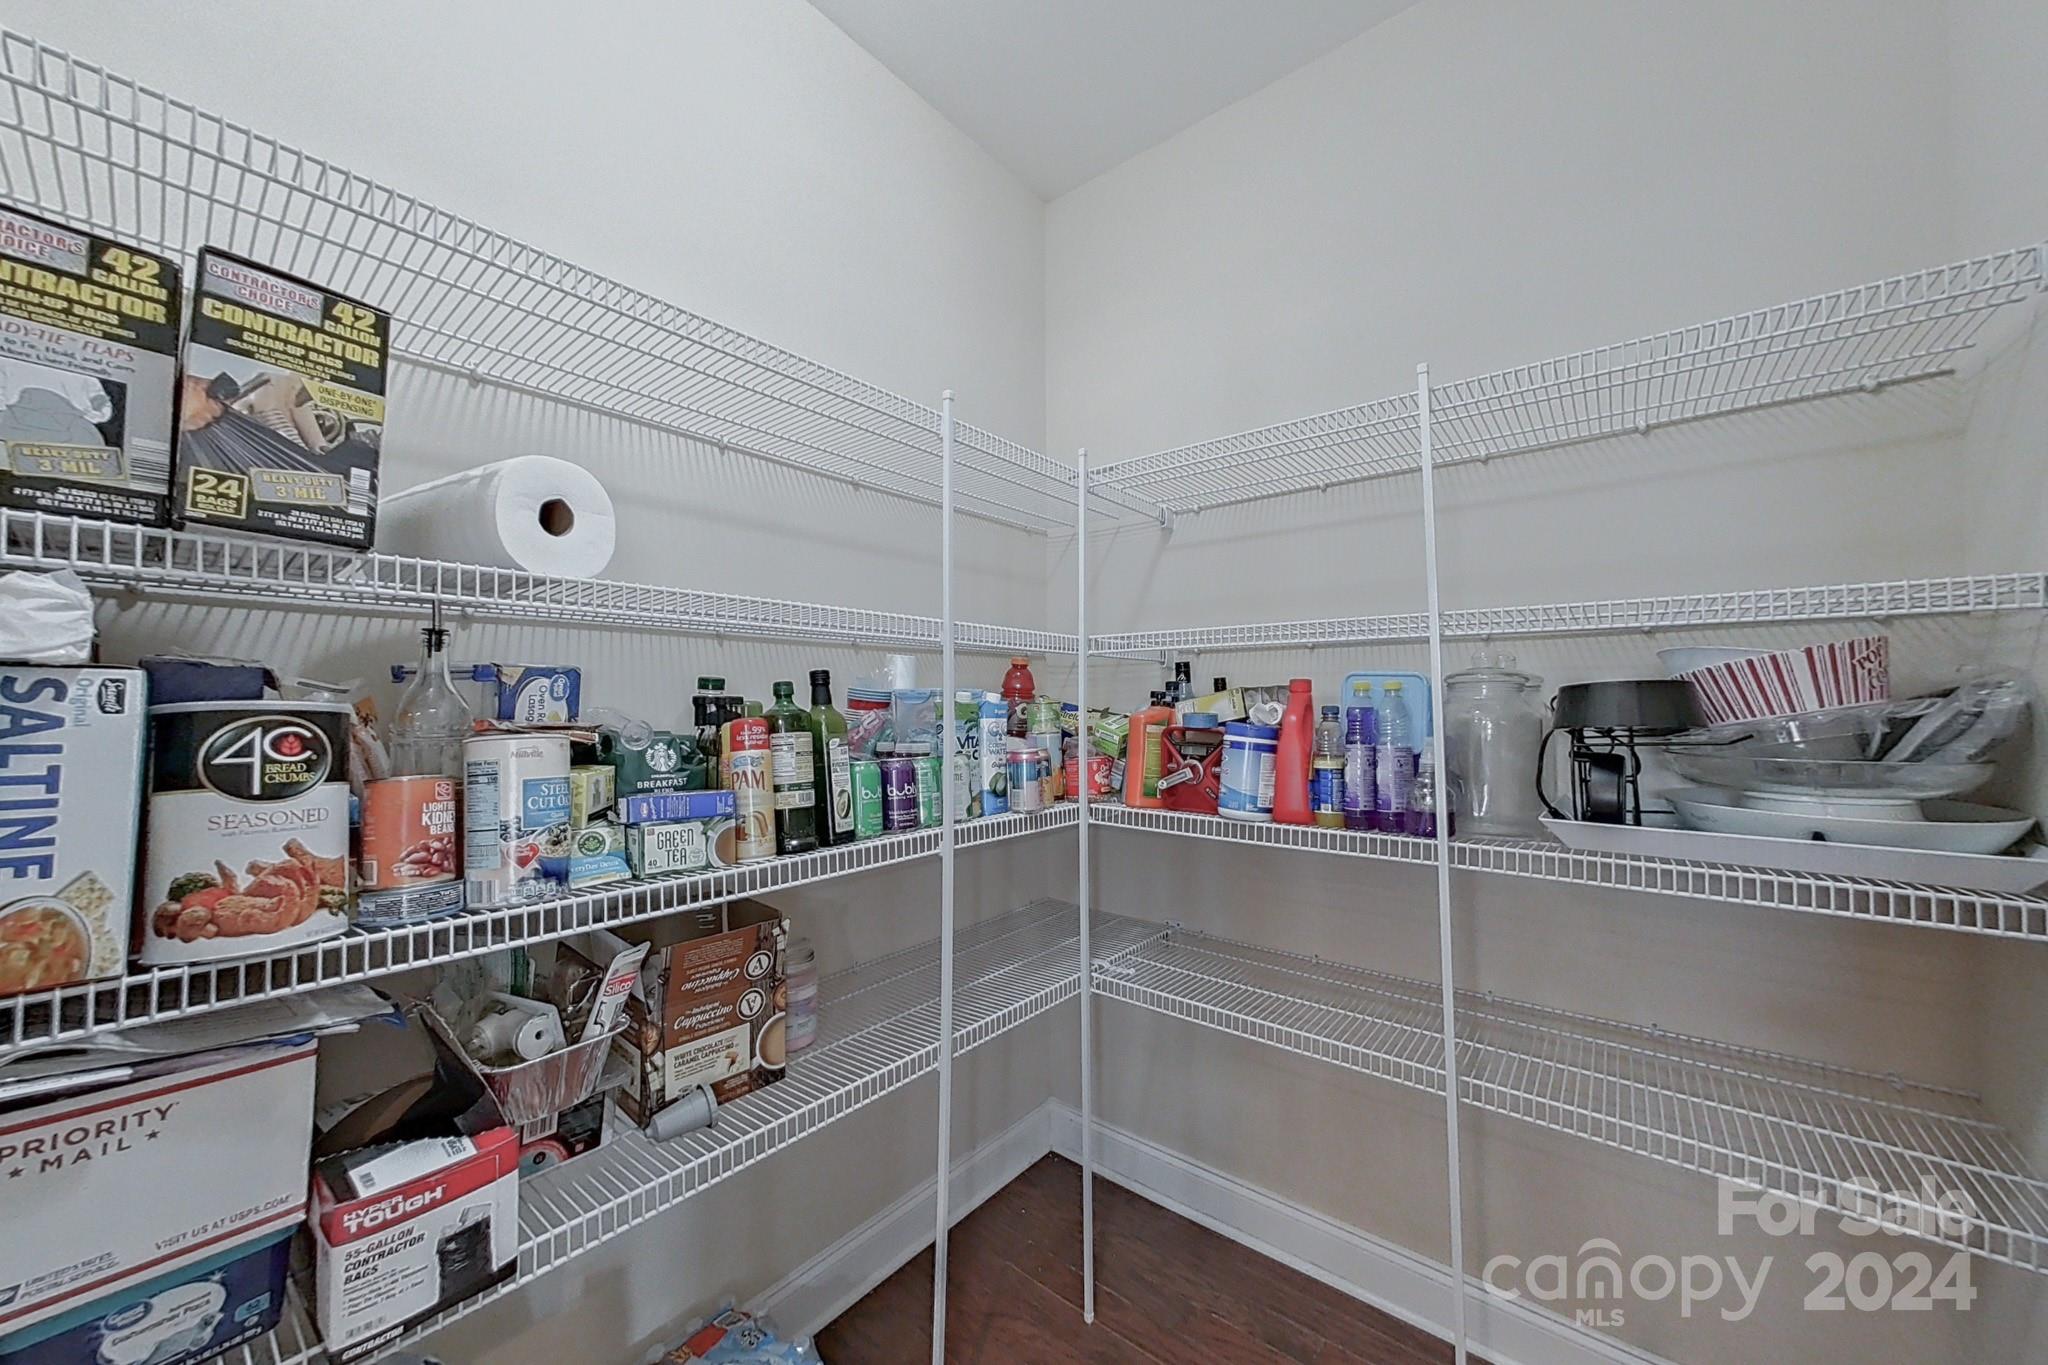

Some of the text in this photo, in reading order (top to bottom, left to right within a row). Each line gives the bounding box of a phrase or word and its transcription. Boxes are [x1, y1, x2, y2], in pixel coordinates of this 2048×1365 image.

[0, 219, 87, 255] ACTOR'S
[101, 247, 161, 285] 42
[92, 269, 168, 301] GALLON
[208, 263, 321, 310] CONTRACTOR'S
[237, 286, 294, 311] CHOICE
[72, 303, 120, 325] BAGS
[332, 301, 377, 334] 42
[202, 297, 380, 369] CONTRACTOR
[323, 320, 382, 348] GALLON
[82, 340, 136, 363] FLAPS
[242, 331, 345, 370] CLEAN-UP BAGS
[319, 396, 374, 416] DISPENSING
[39, 460, 101, 474] 3 MIL
[193, 473, 242, 499] 24
[275, 486, 327, 500] 3 MIL
[304, 476, 334, 488] DUTY
[196, 494, 238, 509] BAGS
[68, 677, 95, 728] Original
[537, 684, 548, 711] Oven
[956, 734, 980, 751] VITA
[209, 725, 315, 796] 4C
[264, 762, 308, 775] BREAD
[0, 675, 69, 880] SALTINE
[263, 771, 316, 785] CRUMBS
[540, 782, 569, 797] STEEL
[636, 777, 688, 790] BREAKFAST
[730, 769, 768, 792] PAM
[423, 801, 447, 812] LIGHT
[527, 795, 557, 810] CUT
[207, 806, 330, 832] SEASONED
[656, 828, 695, 851] GREEN
[647, 858, 659, 868] 40
[664, 846, 688, 868] TEA
[673, 1004, 734, 1031] Cappuccino
[673, 1039, 724, 1062] WHITE CHOCOLATE
[673, 1055, 701, 1069] CARAMEL
[700, 1042, 735, 1059] CAPPUCCINO
[0, 1102, 174, 1164] PRIORITY
[39, 1136, 133, 1174] MAIL
[342, 1194, 404, 1222] HYPER
[343, 1185, 445, 1234] TOUGH
[154, 1232, 188, 1251] VISIT
[190, 1224, 209, 1238] US
[211, 1217, 227, 1231] AT
[344, 1225, 416, 1262] 55-GALLON
[344, 1231, 426, 1274] CONTRACTOR
[343, 1263, 380, 1286] BAGS
[341, 1325, 404, 1360] CONTRACTOR
